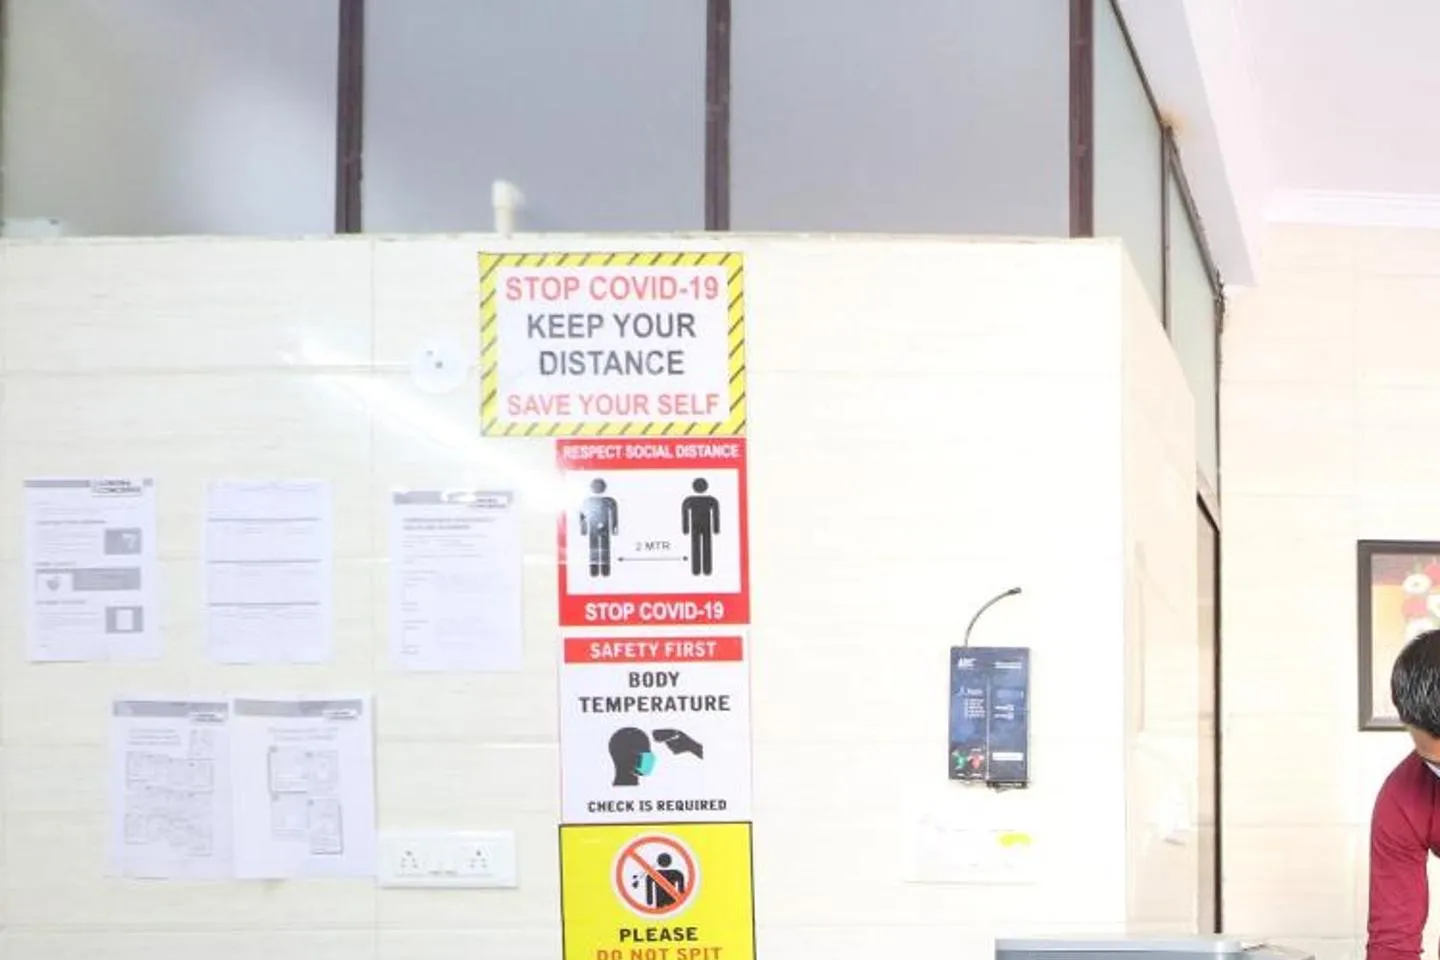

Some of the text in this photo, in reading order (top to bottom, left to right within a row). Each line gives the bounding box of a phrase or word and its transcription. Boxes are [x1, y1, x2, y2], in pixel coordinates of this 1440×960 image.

[505, 275, 719, 301] STOP COVID-19
[527, 313, 697, 338] KEEP YOUR
[539, 350, 685, 376] DISTANCE
[507, 393, 720, 416] SAVE YOUR SELF
[564, 444, 739, 459] RESPECT SOCIAL DISTANCE
[585, 600, 724, 621] STOP COVID-19
[589, 641, 717, 659] SAFETY FIRST
[628, 671, 680, 688] BODY
[578, 695, 731, 713] TEMPERATURE
[587, 799, 727, 813] CHECK IS REQUIRED
[619, 927, 698, 942] PLEASE
